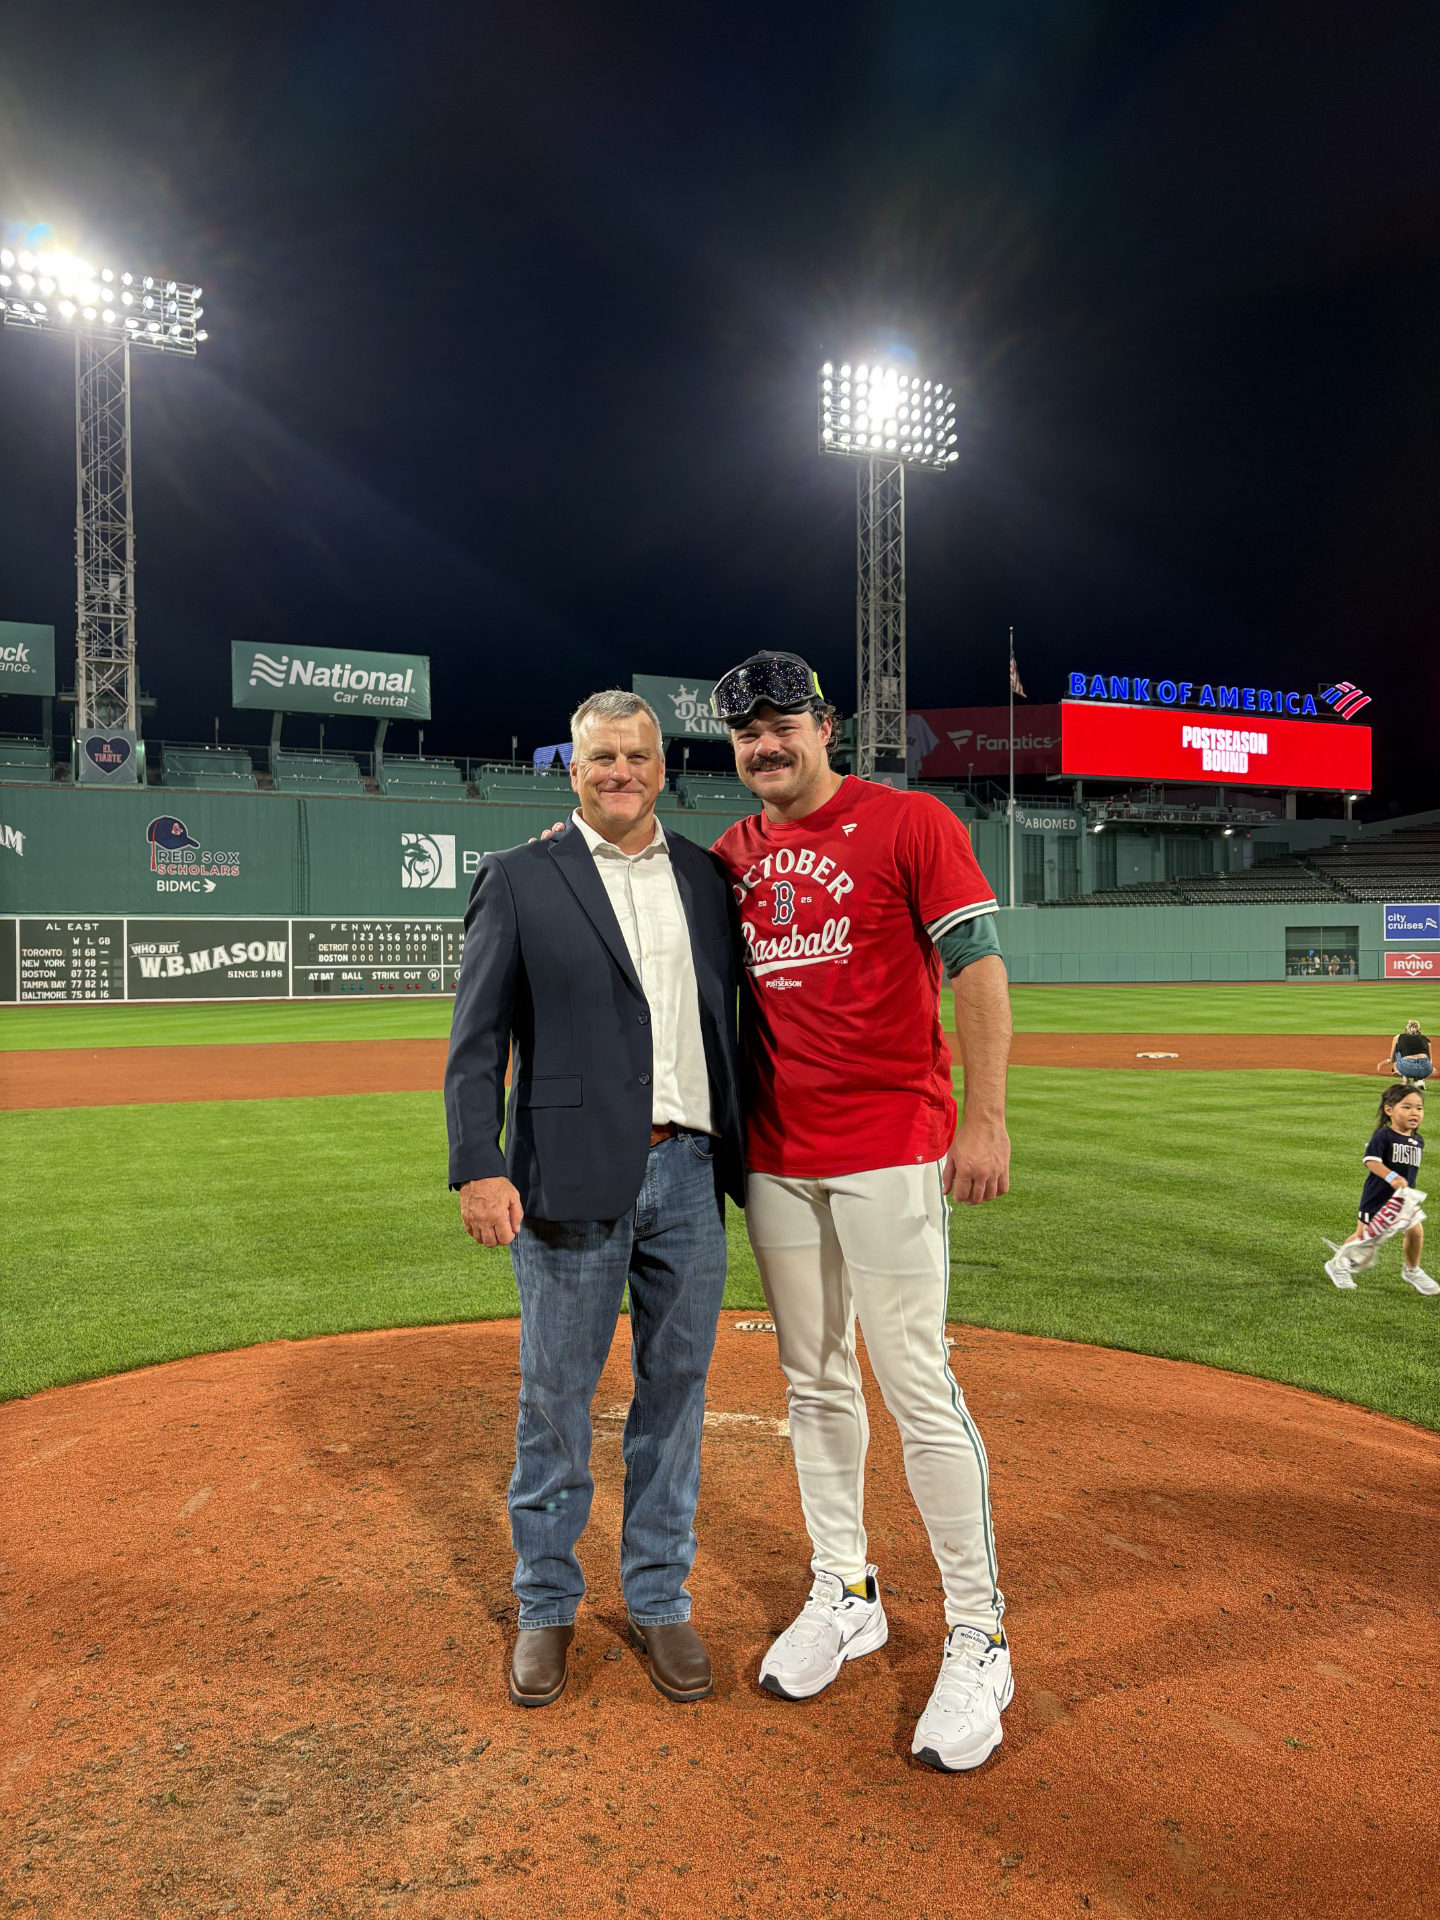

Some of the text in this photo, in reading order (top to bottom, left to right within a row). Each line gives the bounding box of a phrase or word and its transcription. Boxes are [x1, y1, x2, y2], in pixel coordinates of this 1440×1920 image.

[1070, 672, 1317, 715] BANK OF AMERICA
[333, 691, 408, 707] Car Rental
[977, 733, 1053, 751] Fanatics
[1182, 725, 1268, 755] POSTSEASON
[103, 744, 112, 753] EL
[1202, 748, 1248, 774] BOUND
[1025, 818, 1076, 830] ABIOMED
[158, 850, 240, 864] RED SOX
[157, 864, 240, 876] SCHOLARS
[733, 848, 854, 906] OCTOBER
[157, 880, 200, 892] BIDMC
[1388, 913, 1406, 922] city
[73, 937, 110, 945] W L GB
[309, 933, 315, 941] P
[360, 933, 365, 941] 2
[368, 933, 373, 941] 3
[741, 917, 853, 965] Baseball
[22, 949, 96, 957] TORONTO 91 68
[132, 943, 179, 954] WHO BUT
[319, 954, 348, 962] BOSTON
[352, 954, 357, 962] 0
[360, 954, 365, 962] 0
[368, 954, 373, 962] 0
[388, 954, 392, 962] 0
[395, 954, 400, 962] 0
[1394, 960, 1433, 969] IRVING
[22, 970, 56, 978] BOSTON
[71, 970, 82, 978] 87
[85, 970, 96, 978] 72
[228, 970, 283, 978] SINCE 1898
[342, 972, 362, 980] BALL
[22, 981, 48, 989] TAMPA
[71, 980, 82, 988] 77
[85, 980, 96, 988] 82
[100, 980, 109, 988] 14
[766, 980, 802, 988] POSTSEASON
[22, 991, 67, 999] BALTIMORE
[100, 990, 109, 998] 16
[1392, 1143, 1422, 1167] BOSTON
